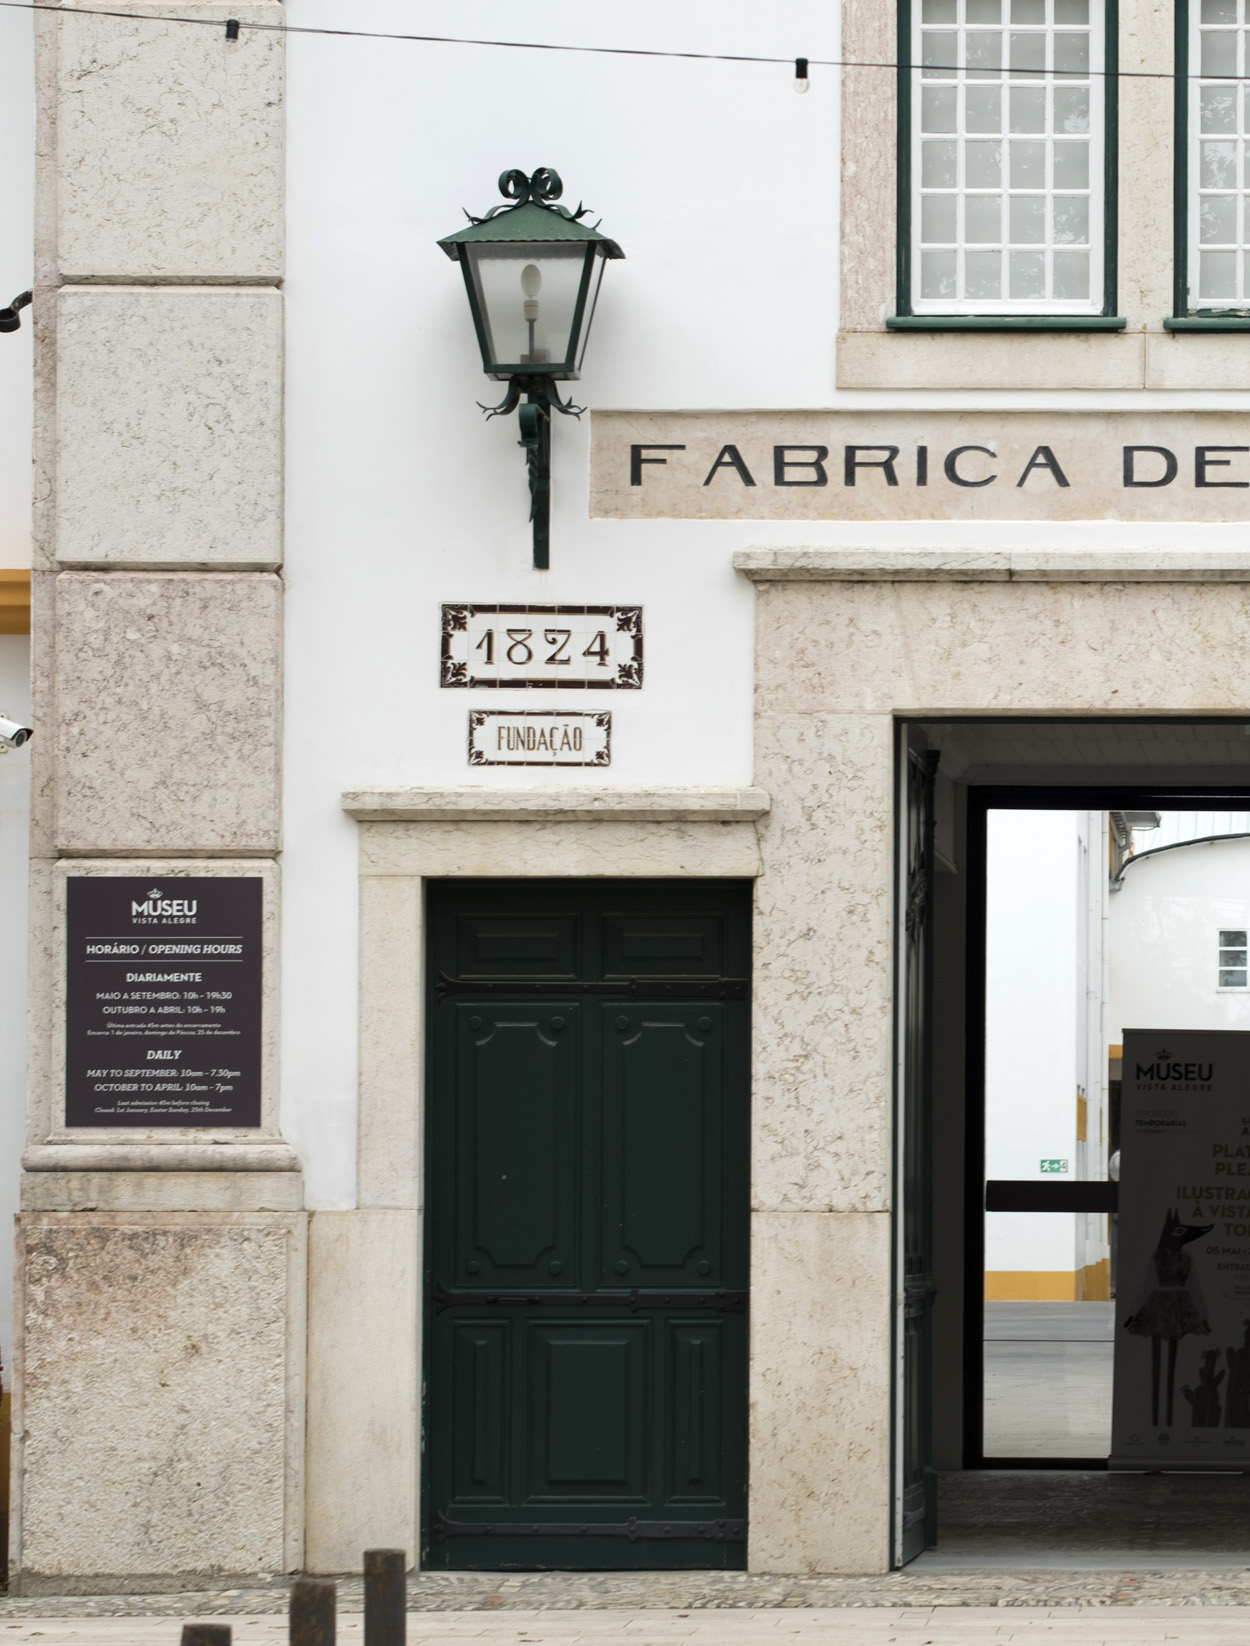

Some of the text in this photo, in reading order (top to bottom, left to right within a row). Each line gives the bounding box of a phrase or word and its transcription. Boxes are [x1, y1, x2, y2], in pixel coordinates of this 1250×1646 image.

[630, 444, 1071, 488] FABRICA
[1122, 445, 1250, 488] DE
[475, 629, 611, 667] 1824
[497, 724, 583, 757] FUNDAÇÃO
[131, 900, 198, 916] MUSEU
[86, 942, 139, 954] HORÁRIO
[148, 944, 201, 954] OPENING
[202, 944, 243, 954] HOURS
[126, 973, 202, 982] DIARIAMENTE
[96, 992, 121, 1000] MAIO
[122, 992, 129, 1000] A
[130, 992, 181, 1000] SETEMBRO:
[183, 992, 198, 1000] 10h
[206, 992, 232, 1000] 19h30
[102, 1006, 148, 1014] OUTUBRO
[149, 1006, 156, 1014] A
[157, 1006, 185, 1014] ABRIL:
[187, 1006, 202, 1014] 10h
[210, 1006, 226, 1014] 19h
[146, 1050, 182, 1060] DAILY
[86, 1069, 109, 1077] MAY
[110, 1069, 123, 1077] TO
[180, 1069, 203, 1077] 10am
[1136, 1063, 1213, 1081] MUSEU
[94, 1083, 139, 1091] OCTOBER
[140, 1083, 153, 1091] TO
[185, 1083, 208, 1091] 10am
[215, 1083, 233, 1093] 7pm
[1136, 1083, 1213, 1091] VISTA ALEGRE
[1135, 1119, 1187, 1127] TEMPORÁRIAS
[1241, 1123, 1249, 1136] À
[1192, 1201, 1204, 1217] À
[1206, 1246, 1219, 1254] 05
[1221, 1247, 1240, 1255] MAI
